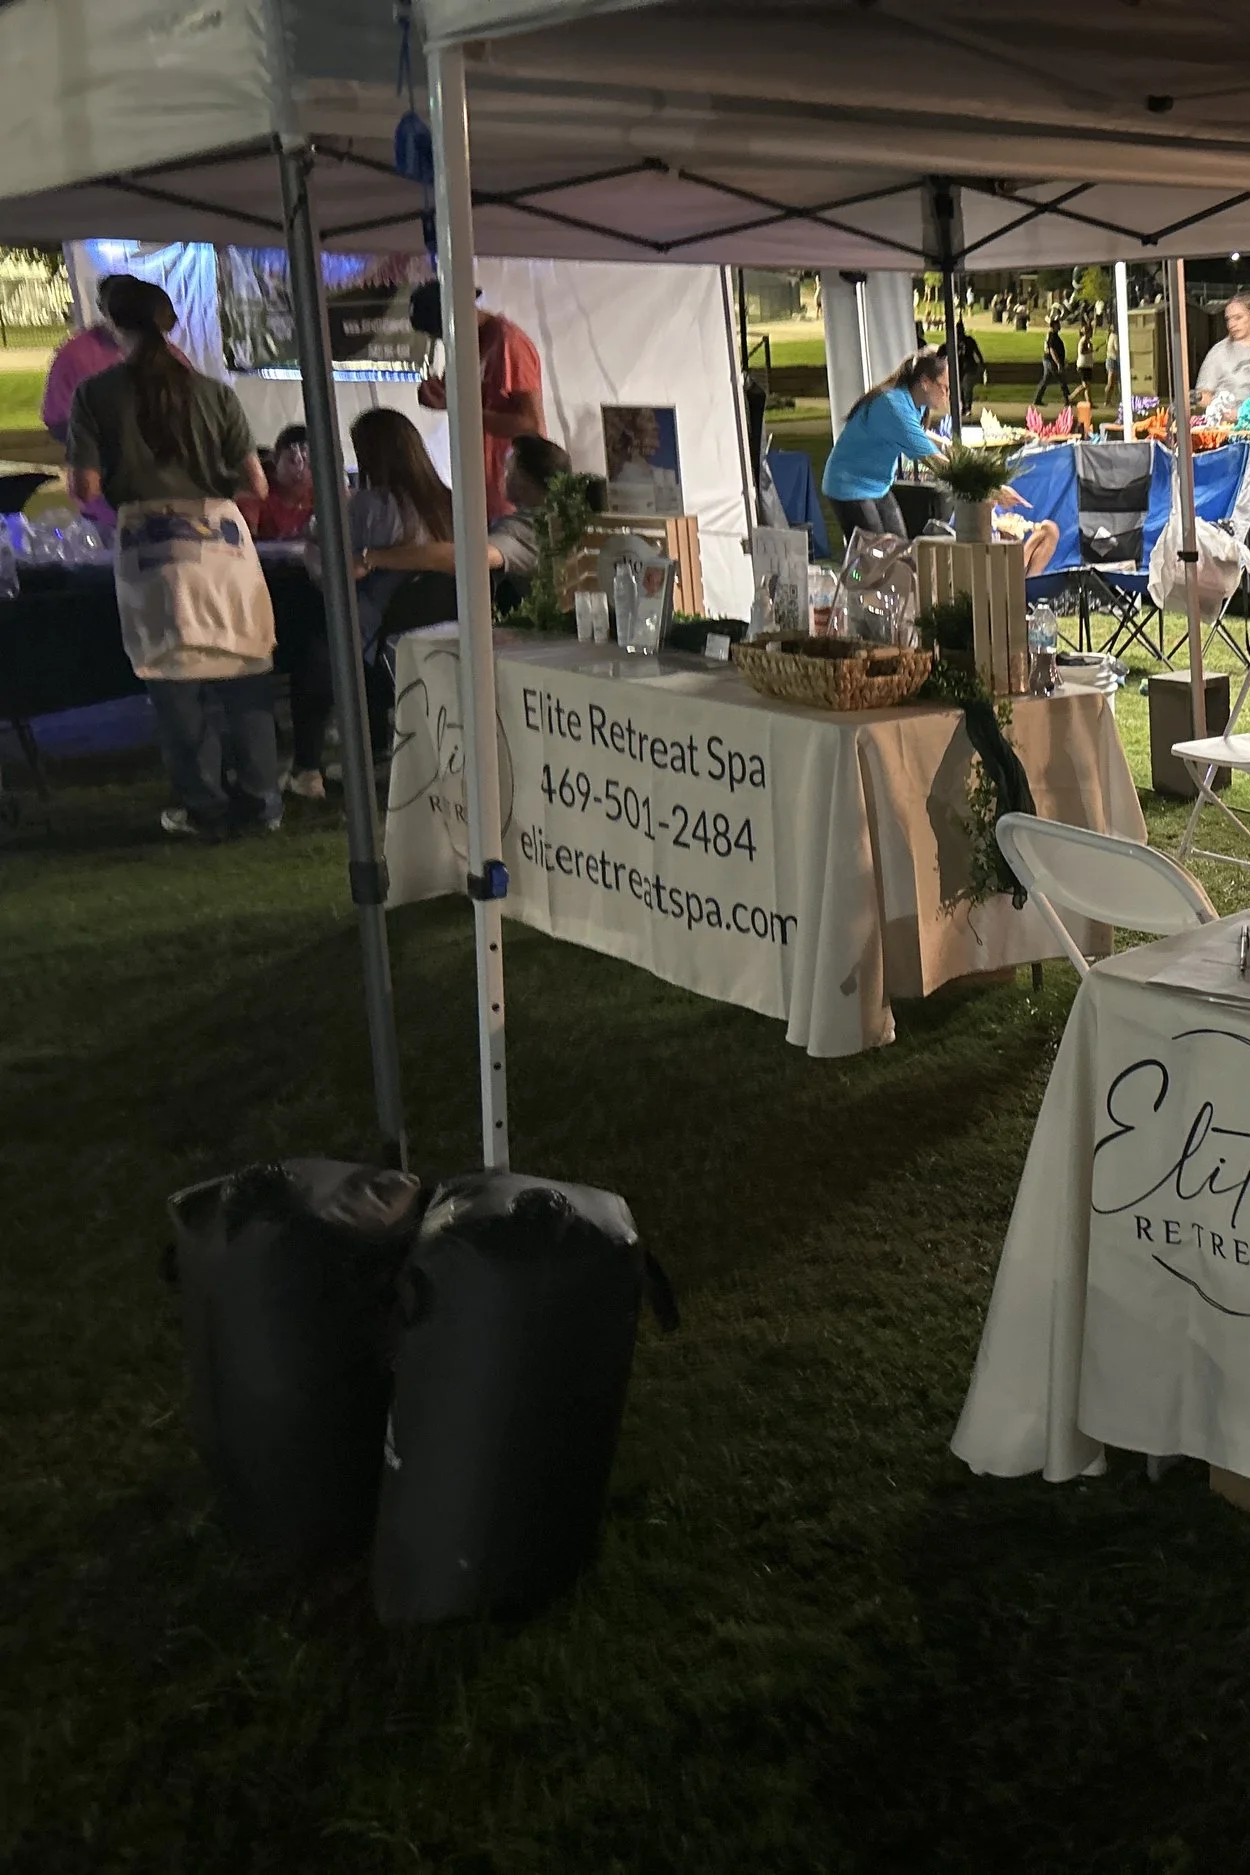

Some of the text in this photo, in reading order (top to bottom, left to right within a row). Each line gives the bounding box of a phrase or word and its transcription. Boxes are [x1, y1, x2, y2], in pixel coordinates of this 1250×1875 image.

[523, 687, 766, 793] Elite Retreat Spa
[541, 764, 757, 862] 469-501-2484
[520, 824, 798, 946] eliteretreatspa.com
